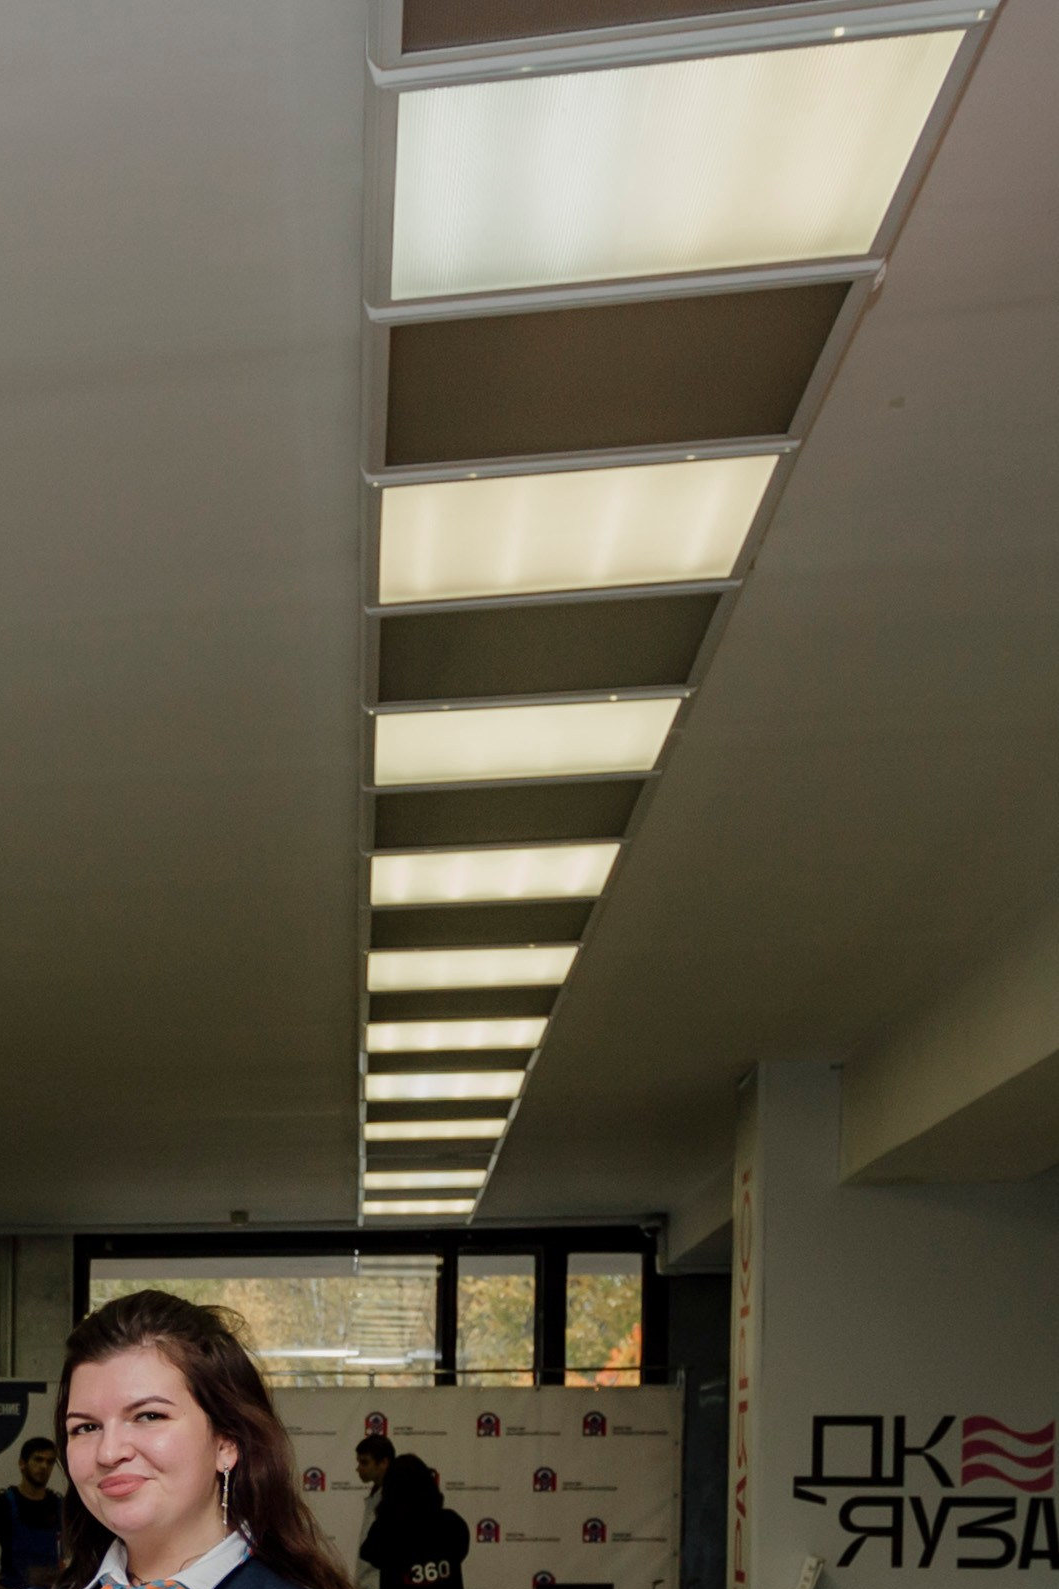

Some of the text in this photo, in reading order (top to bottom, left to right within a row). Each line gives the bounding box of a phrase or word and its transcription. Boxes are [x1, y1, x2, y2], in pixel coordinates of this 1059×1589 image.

[794, 1416, 956, 1505] ДК
[836, 1496, 1059, 1570] ЯУЗА
[411, 1560, 450, 1583] 360
